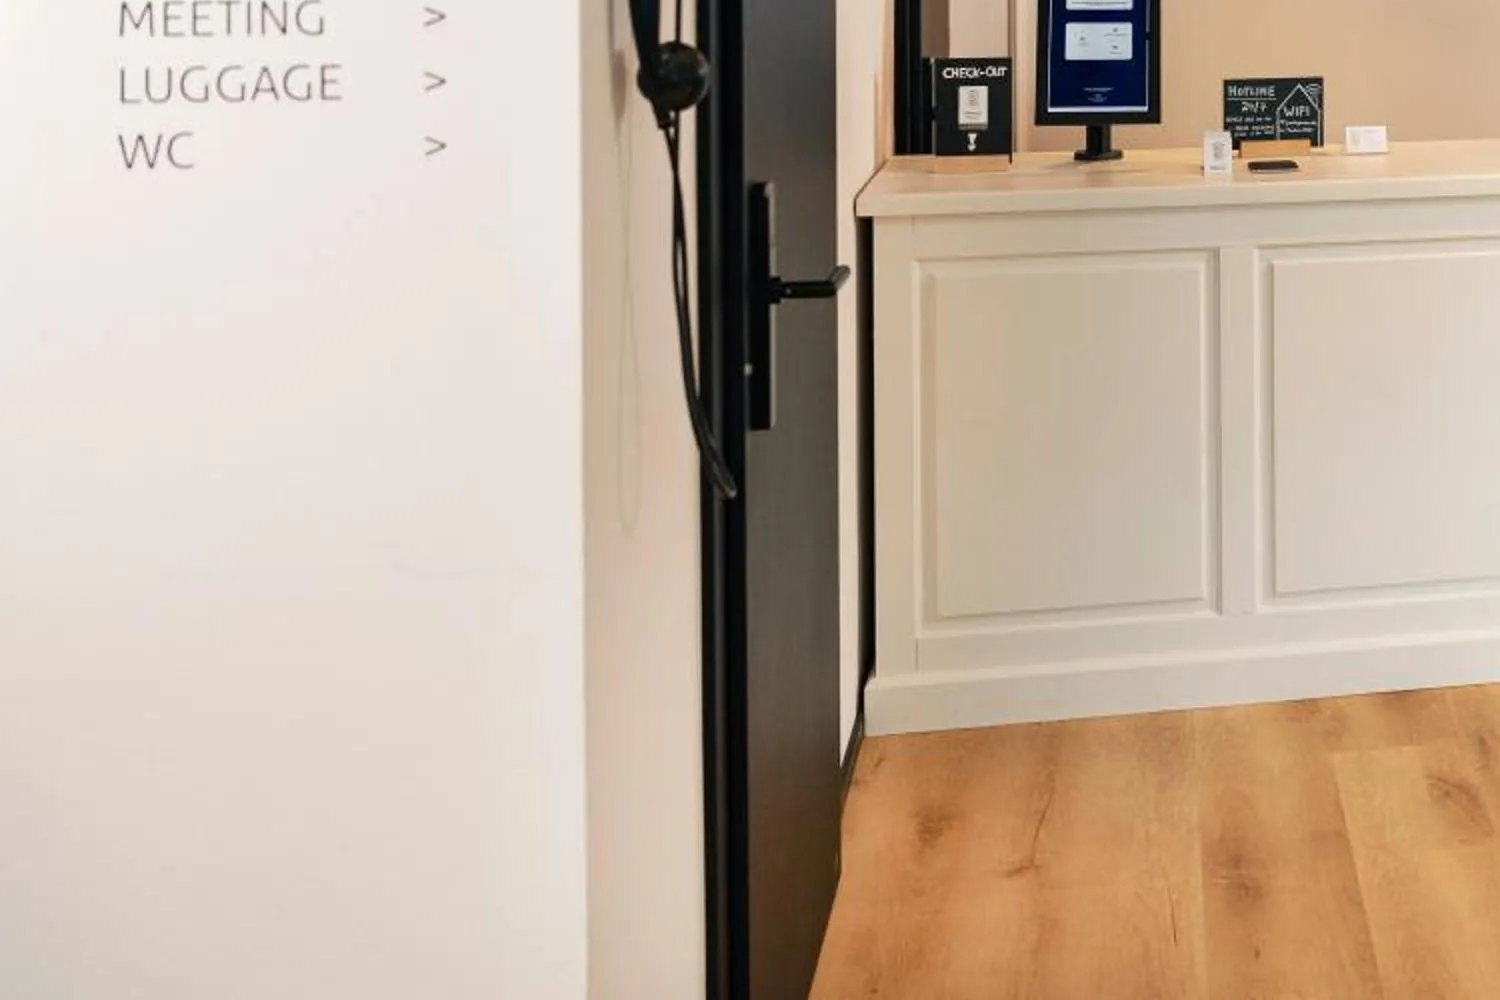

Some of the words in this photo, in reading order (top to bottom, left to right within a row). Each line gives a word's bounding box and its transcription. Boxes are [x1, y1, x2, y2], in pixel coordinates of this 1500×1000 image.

[118, 0, 325, 37] MEETING
[119, 64, 343, 104] LUGGAGE
[942, 65, 1008, 79] CHECK-OUT
[118, 131, 195, 169] WC
